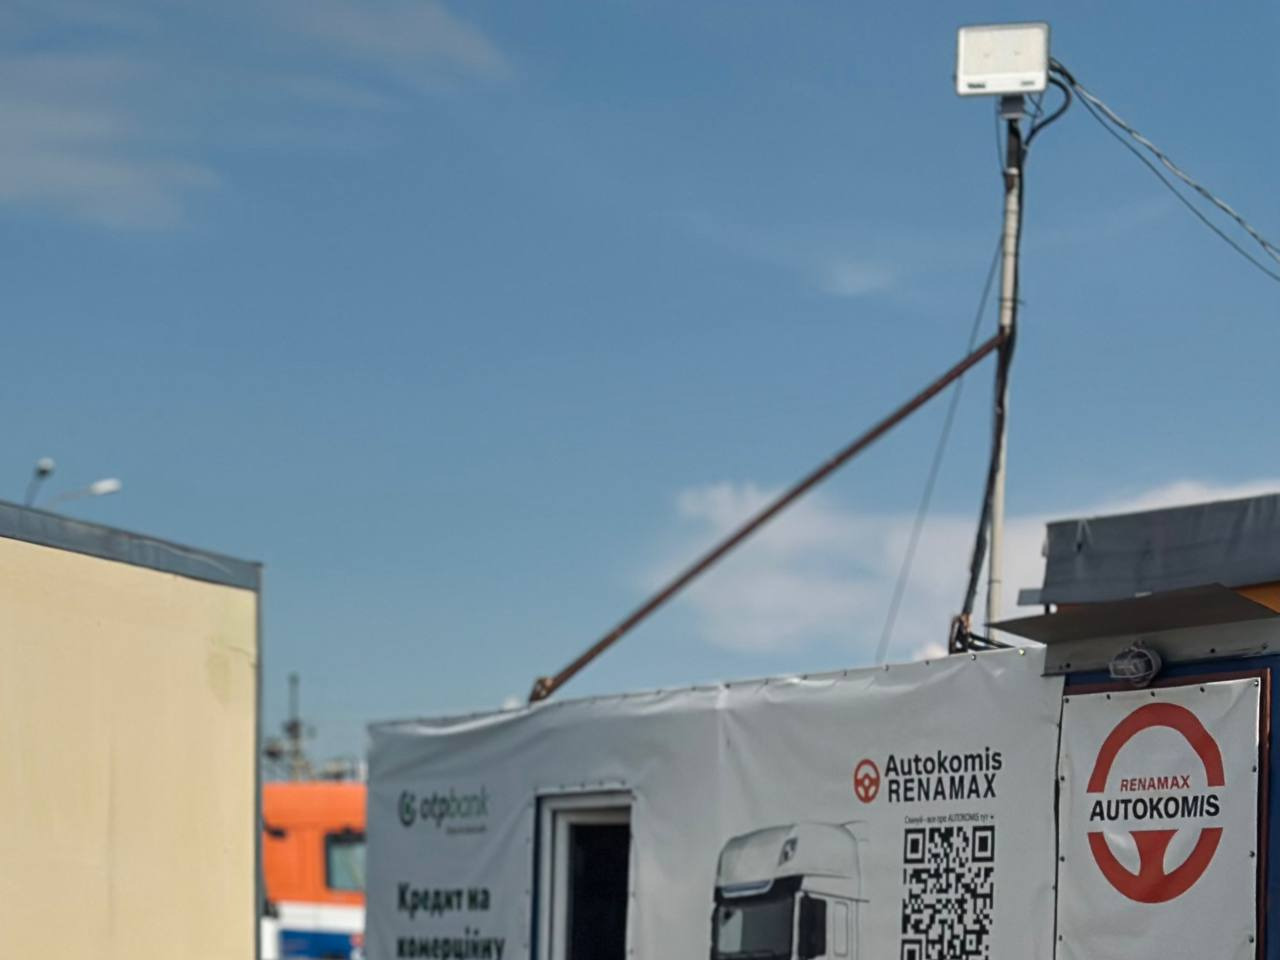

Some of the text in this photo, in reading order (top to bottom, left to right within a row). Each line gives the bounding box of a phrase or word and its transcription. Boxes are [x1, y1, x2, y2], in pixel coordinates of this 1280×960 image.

[884, 746, 1002, 777] Autokomis
[888, 773, 997, 803] RENAMAX
[1120, 775, 1191, 792] RENAMAX
[1089, 794, 1221, 821] AUTOKOMIS
[397, 881, 491, 919] Кредит на
